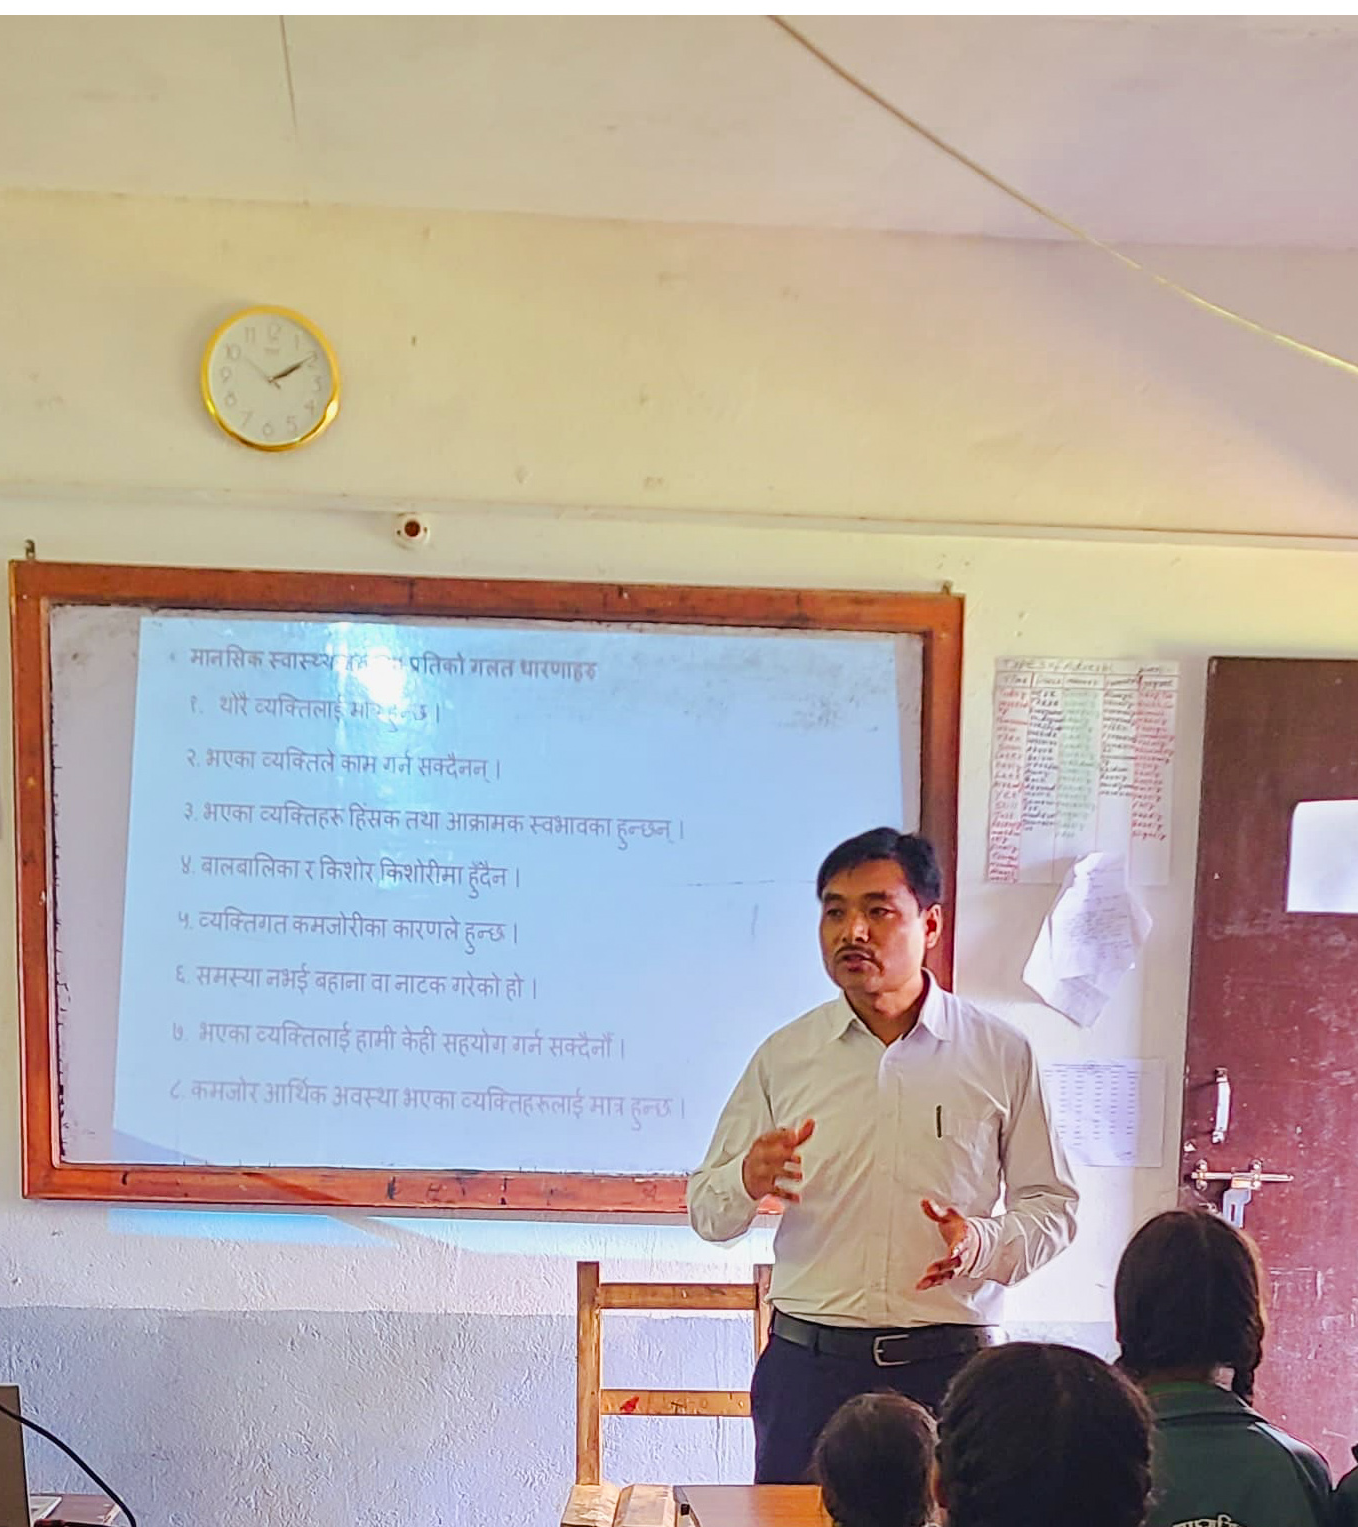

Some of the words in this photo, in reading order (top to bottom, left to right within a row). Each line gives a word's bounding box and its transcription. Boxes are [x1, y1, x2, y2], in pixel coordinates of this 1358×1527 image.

[191, 644, 262, 668] मानसिक
[470, 658, 514, 679] गलत
[255, 692, 343, 721] व्यक्तिलाई
[206, 748, 257, 770] भएका
[262, 745, 335, 772] व्यक्तिले
[341, 754, 376, 774] काम
[383, 748, 412, 776] गर्न
[203, 803, 256, 823] भएका
[405, 810, 441, 831] तथा
[446, 812, 525, 834] आक्रामक
[529, 814, 613, 837] स्वभावका
[200, 852, 300, 878] बालबालिका
[305, 861, 316, 880] र
[319, 854, 375, 882] किशोर
[380, 855, 463, 886] किशोरीमा
[198, 906, 289, 934] व्यक्तिगत
[293, 911, 388, 938] कमजोरीका
[393, 916, 460, 941] कारणले
[465, 922, 506, 955] हुन्छ
[197, 966, 263, 988] समस्या
[266, 963, 310, 994] नभई
[315, 970, 367, 993] बहाना
[371, 972, 392, 993] वा
[395, 973, 447, 995] नाटक
[451, 971, 502, 998] गरेको
[506, 972, 525, 1001] हो
[199, 1022, 251, 1044] भएका
[256, 1019, 352, 1053] व्यक्तिलाई
[356, 1024, 396, 1053] हामी
[402, 1025, 436, 1054] केही
[442, 1029, 508, 1057] सहयोग
[512, 1029, 543, 1056] गर्न
[191, 1076, 260, 1103] कमजोर
[263, 1077, 327, 1104] आर्थिक
[332, 1085, 398, 1109] अवस्था
[403, 1088, 456, 1111] भएका
[589, 1097, 625, 1117] मात्र
[630, 1098, 673, 1132] हुन्छ
